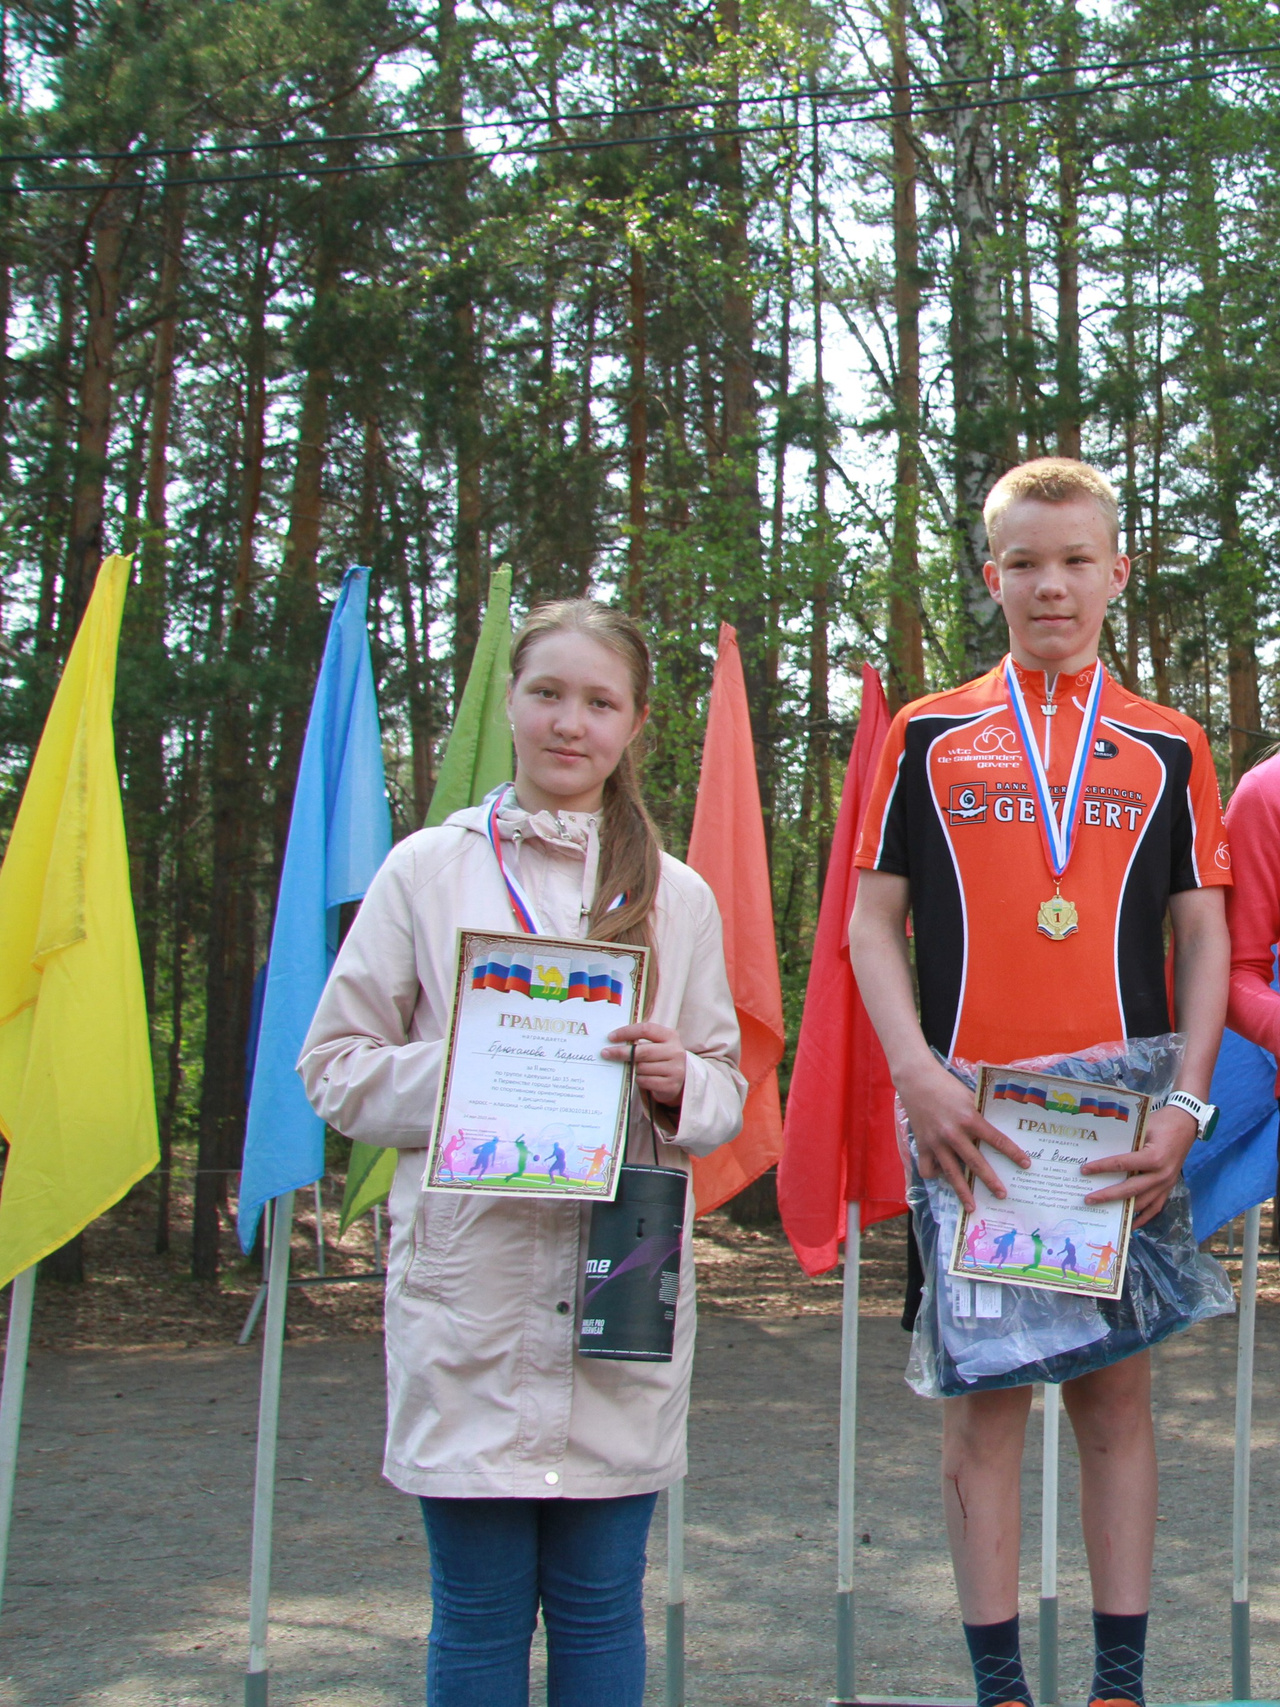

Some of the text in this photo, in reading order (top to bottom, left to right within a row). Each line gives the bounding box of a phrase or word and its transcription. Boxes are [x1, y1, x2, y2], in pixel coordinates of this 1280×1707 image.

[996, 782, 1027, 790] BANK
[1054, 912, 1060, 922] 1
[498, 1013, 590, 1034] ГРАМОТА
[1017, 1119, 1098, 1140] ГРАМОТА
[1038, 1138, 1078, 1146] награждается
